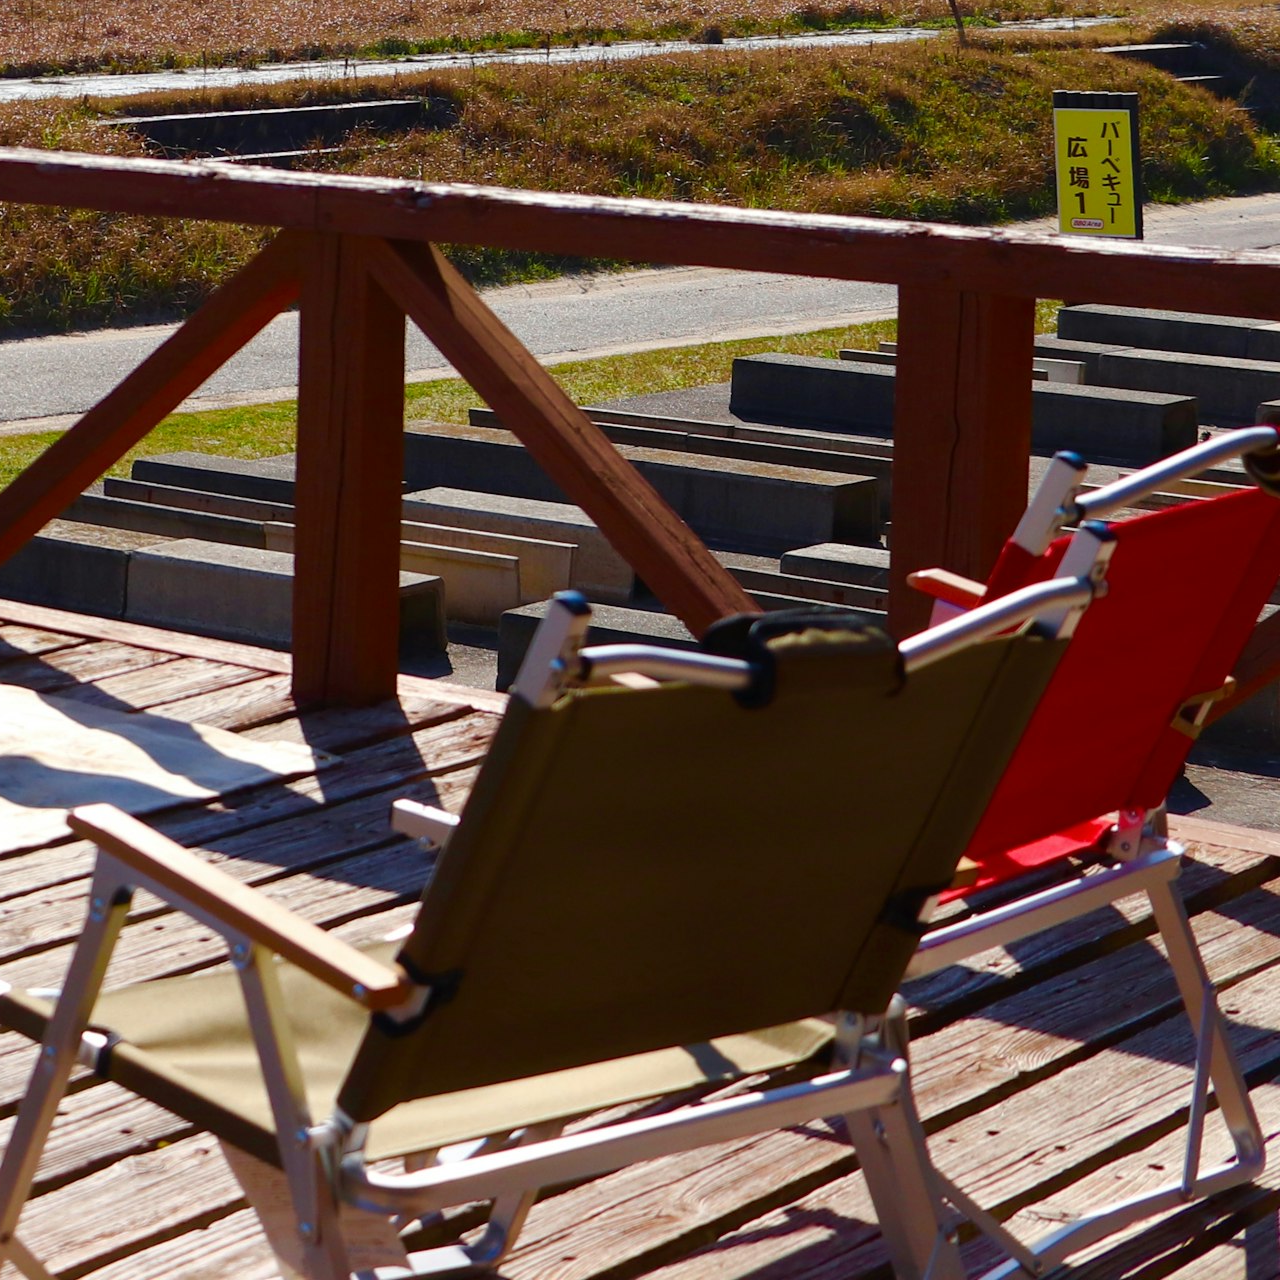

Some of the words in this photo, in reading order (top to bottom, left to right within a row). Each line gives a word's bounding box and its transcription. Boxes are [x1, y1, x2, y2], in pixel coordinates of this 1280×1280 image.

[1100, 121, 1122, 223] バーベキュー
